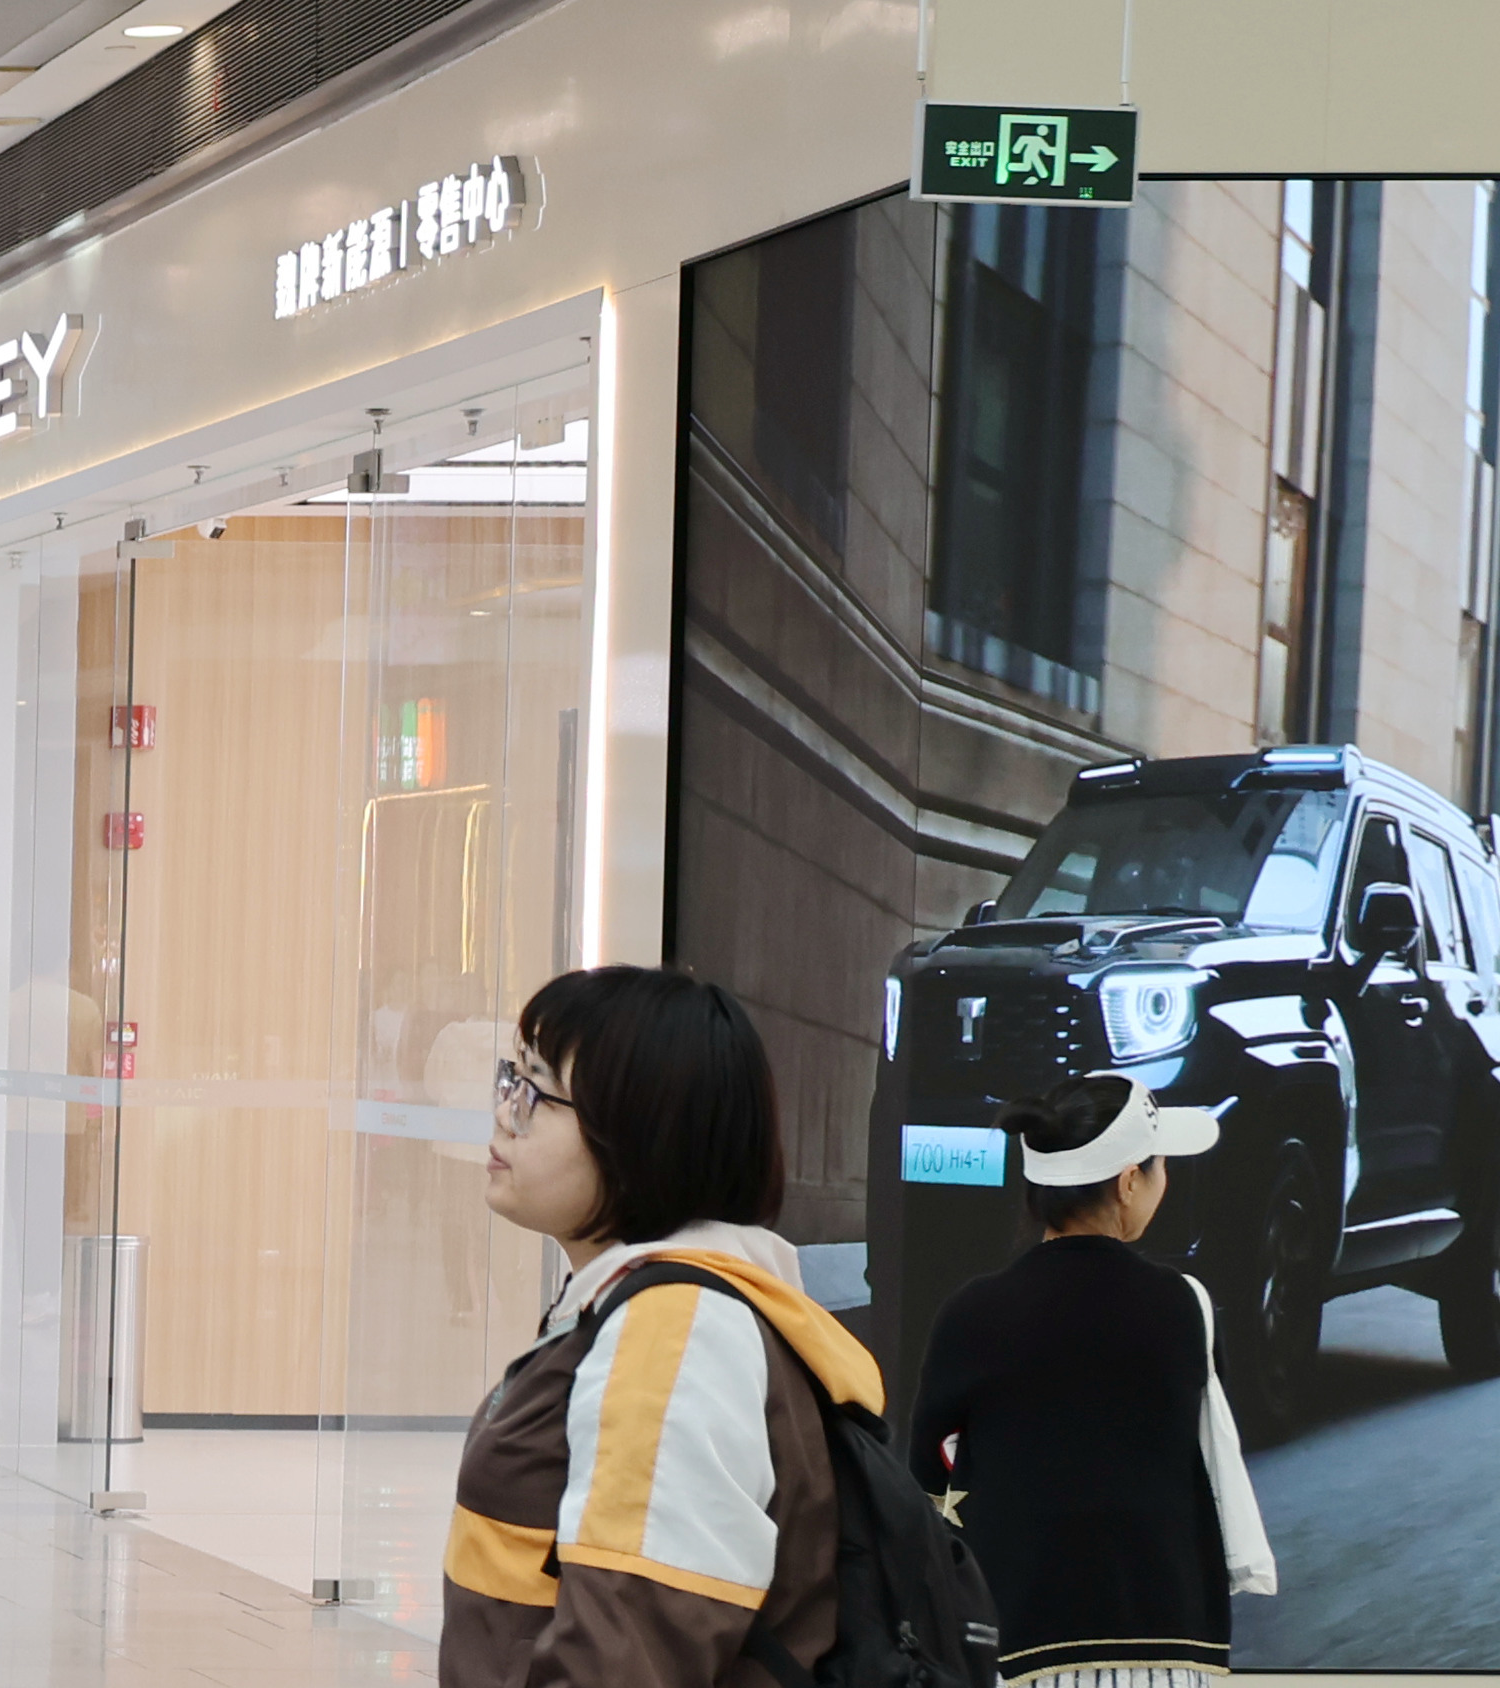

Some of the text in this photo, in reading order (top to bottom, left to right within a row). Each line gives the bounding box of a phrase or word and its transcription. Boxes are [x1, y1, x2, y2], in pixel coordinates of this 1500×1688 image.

[945, 140, 995, 157] 安全出口
[949, 157, 989, 168] EXIT
[912, 1143, 987, 1174] 700 Hi4-T
